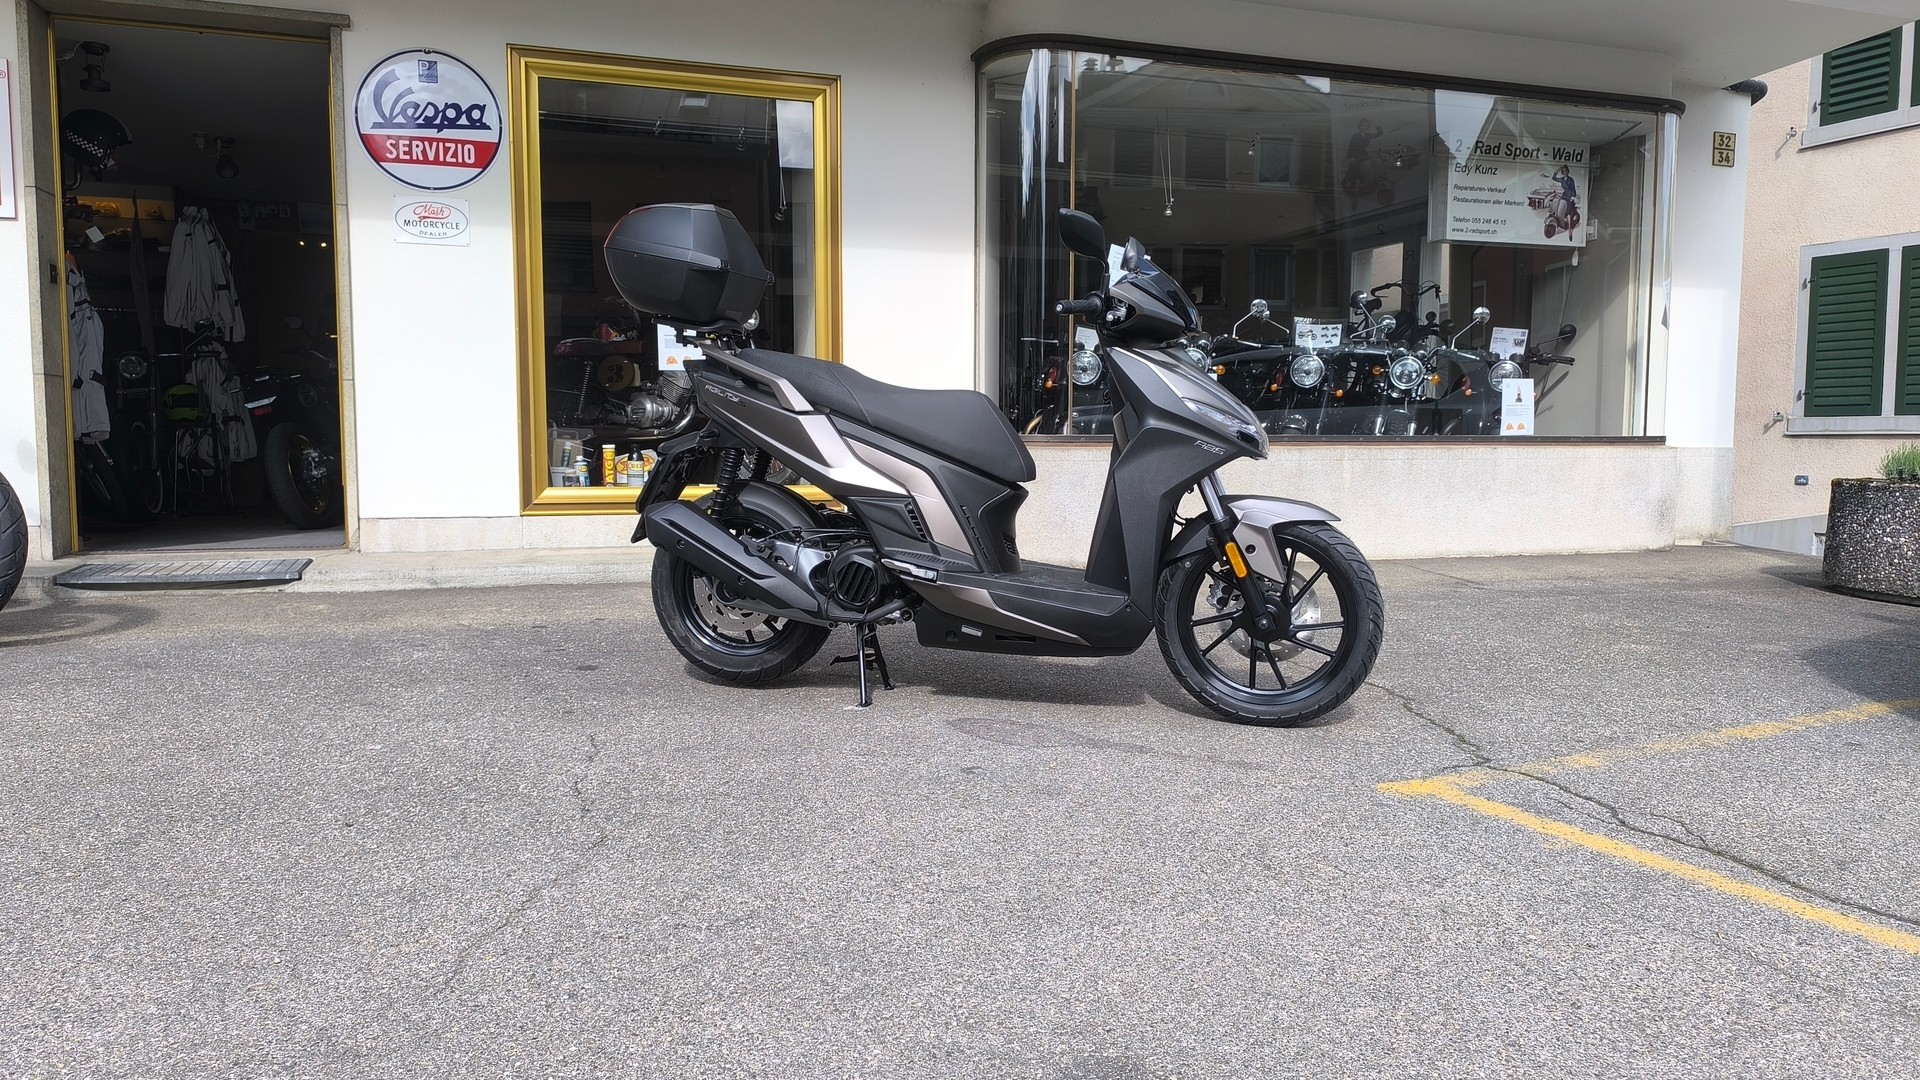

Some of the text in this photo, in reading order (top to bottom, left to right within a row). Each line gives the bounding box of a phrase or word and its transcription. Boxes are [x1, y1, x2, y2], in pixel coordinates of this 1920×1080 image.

[371, 69, 491, 134] Vespa
[1718, 134, 1731, 148] 32
[385, 138, 475, 164] SERVIZIO
[1455, 139, 1463, 153] 2
[1474, 140, 1502, 156] Rad
[1504, 142, 1541, 160] Sport
[1552, 146, 1584, 162] Wald
[1718, 151, 1731, 165] 34
[1454, 162, 1498, 176] Edy Kunz
[403, 219, 460, 230] MOTORCYCLE
[1193, 440, 1226, 455] ABS
